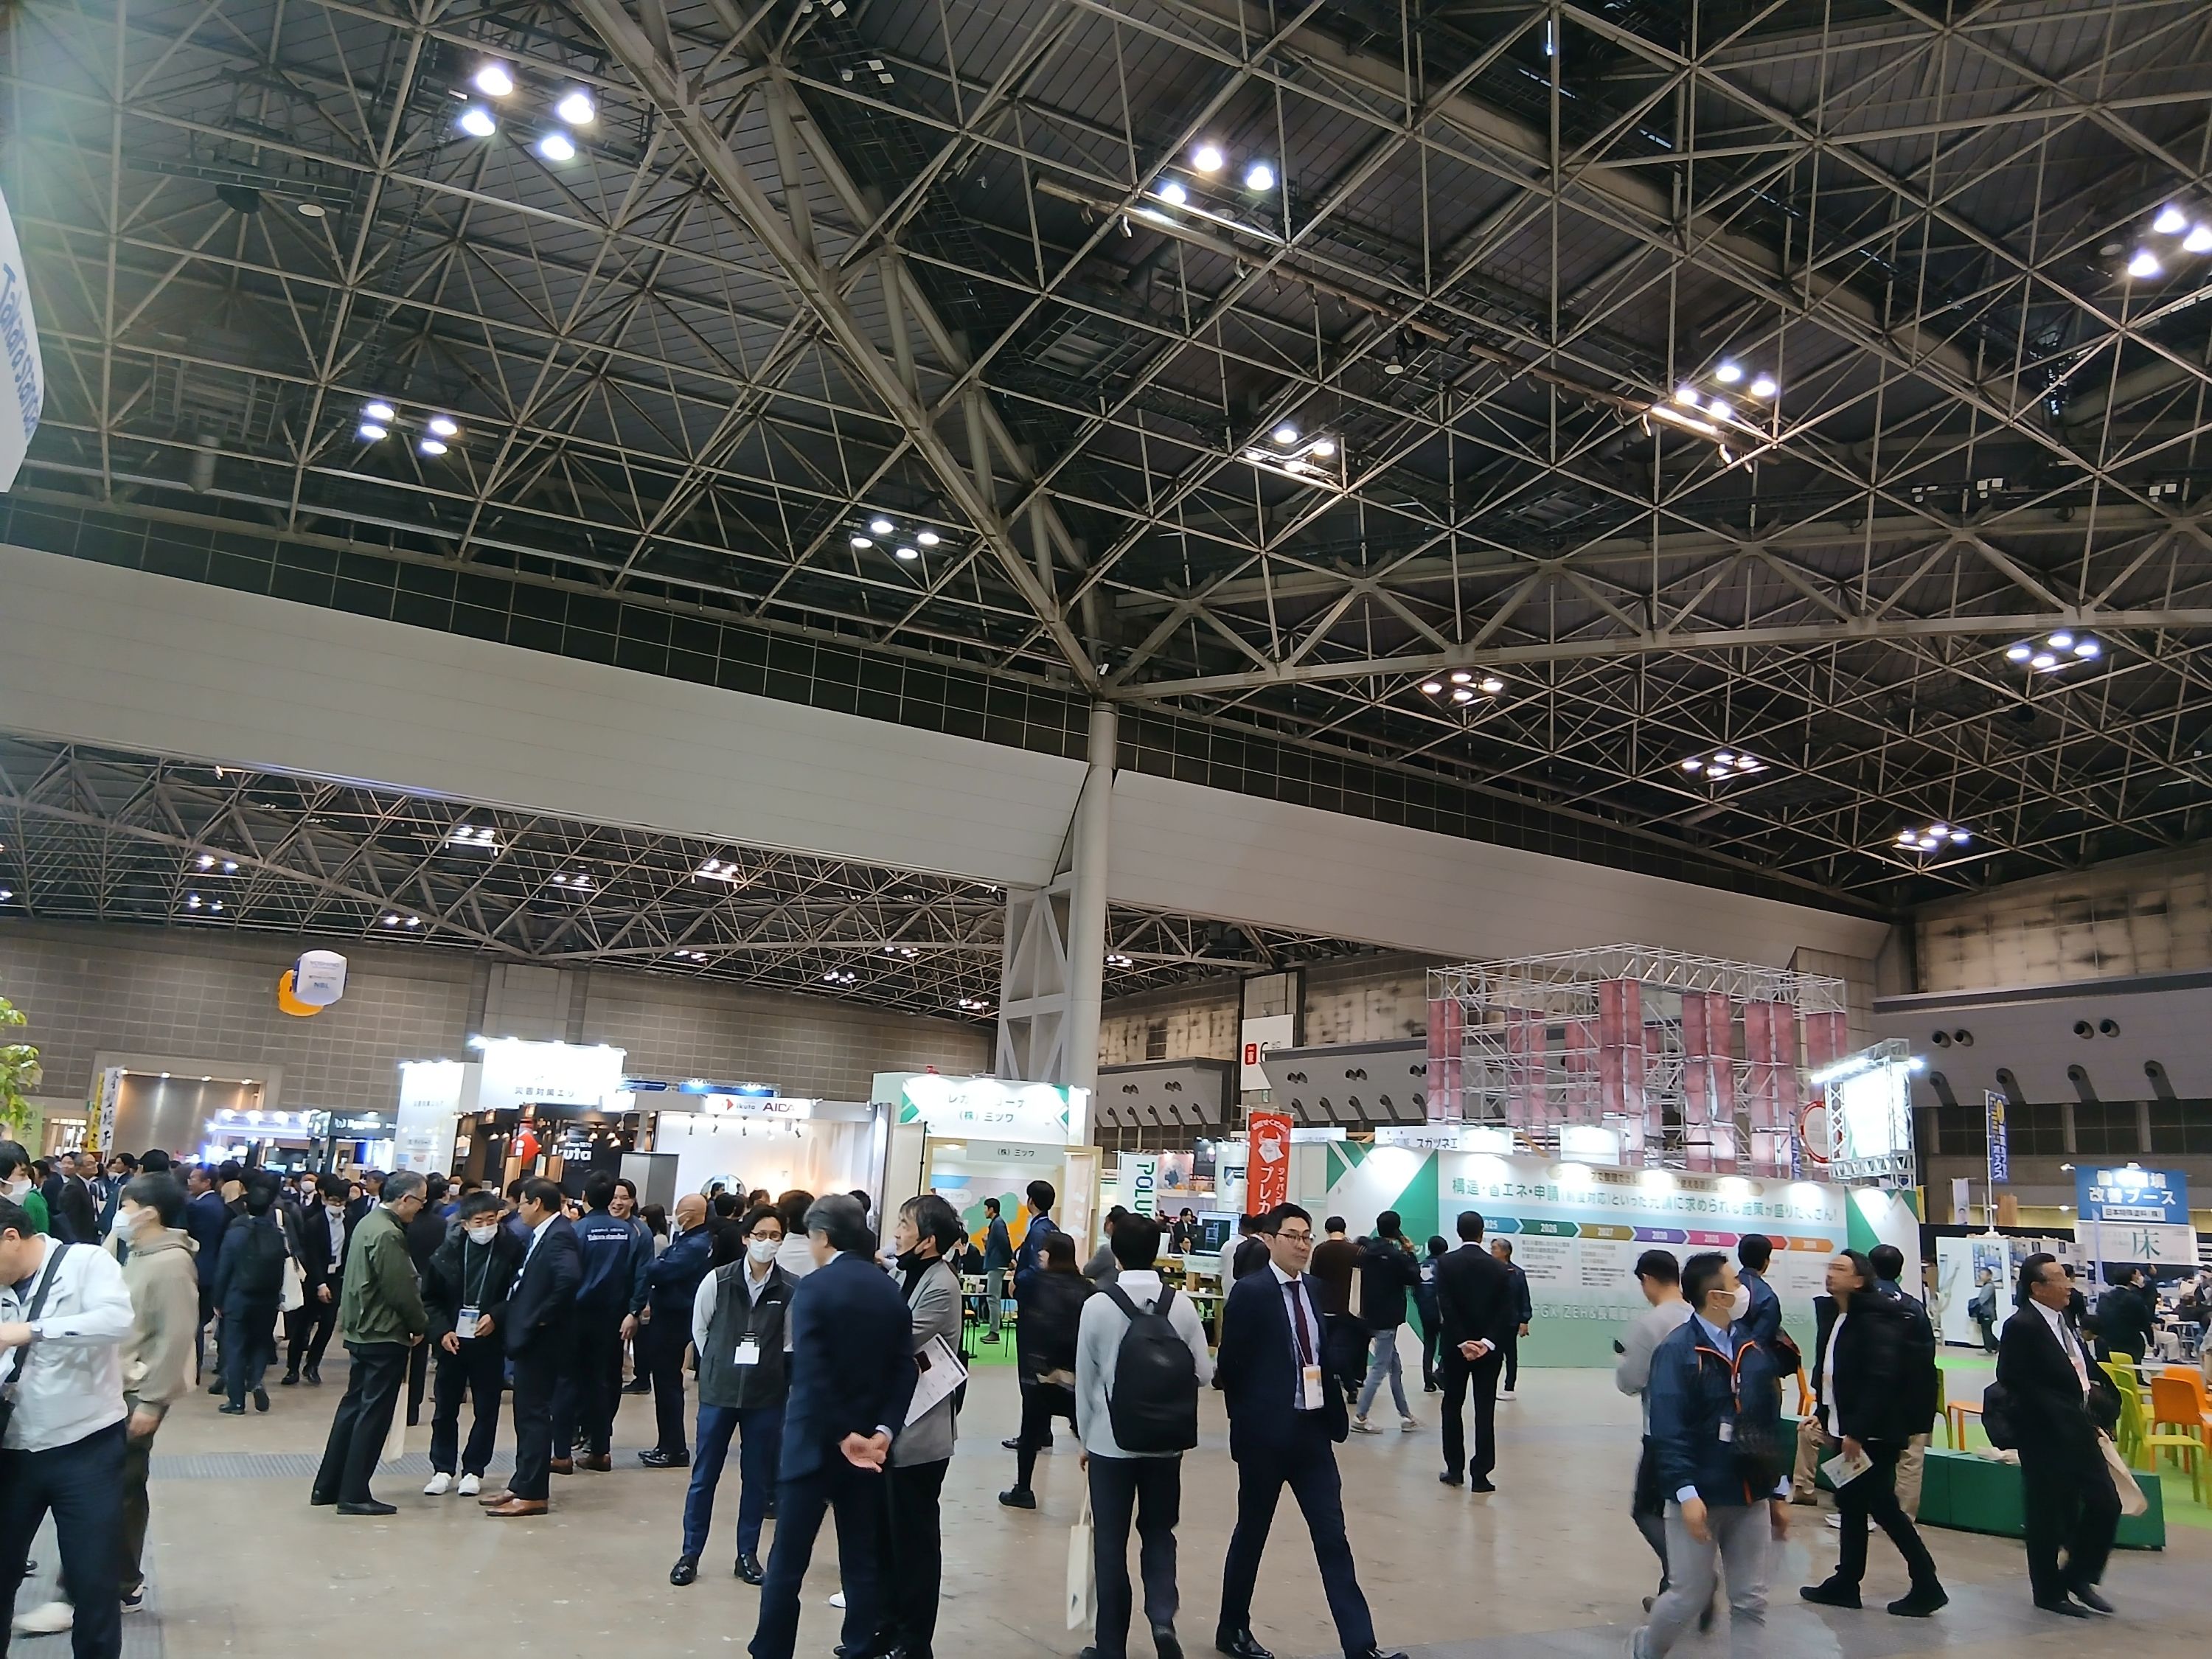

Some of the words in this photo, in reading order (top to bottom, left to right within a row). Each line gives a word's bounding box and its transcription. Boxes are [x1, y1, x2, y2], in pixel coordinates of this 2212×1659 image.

[1134, 1161, 1155, 1219] POLU
[2088, 1186, 2177, 1206] 改善ブース
[2132, 1228, 2161, 1260] 床
